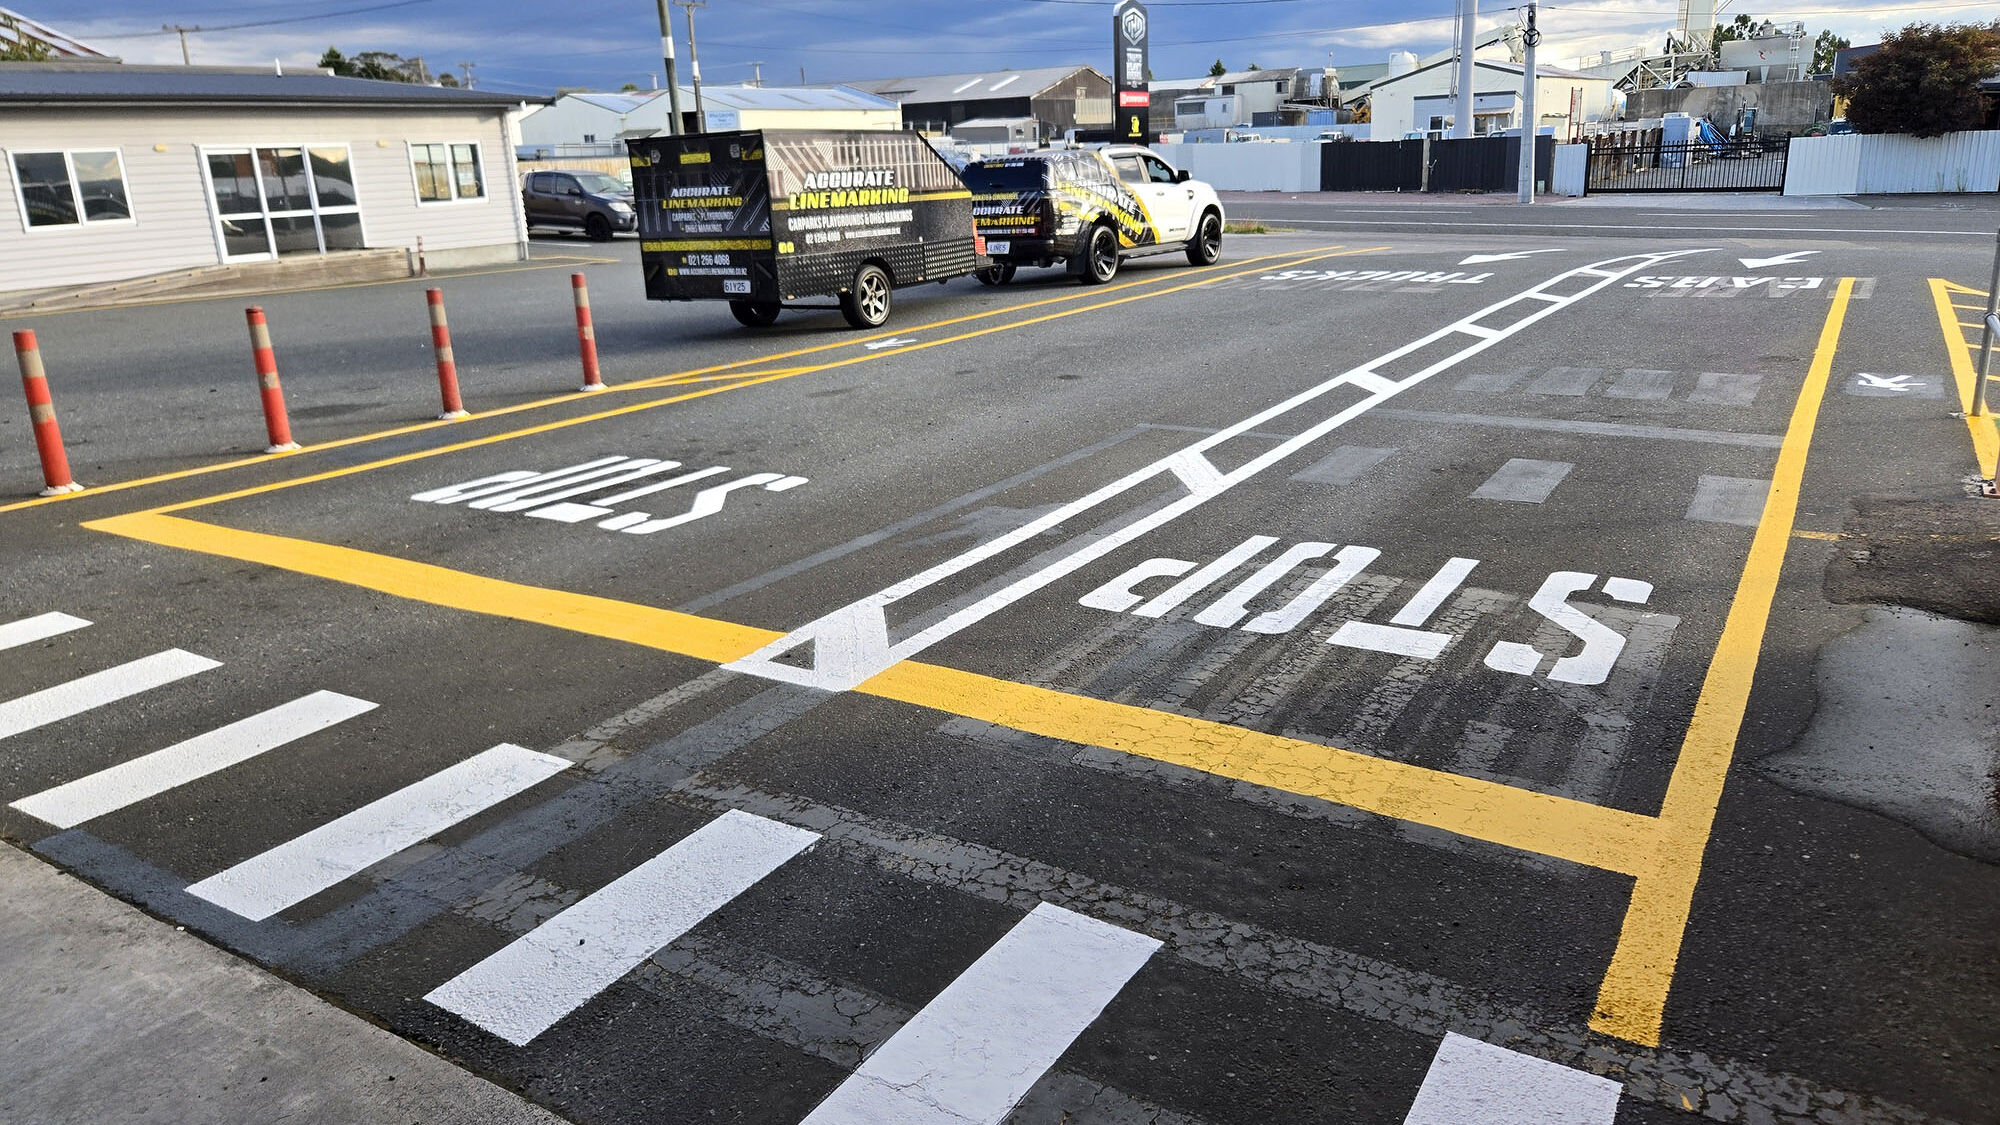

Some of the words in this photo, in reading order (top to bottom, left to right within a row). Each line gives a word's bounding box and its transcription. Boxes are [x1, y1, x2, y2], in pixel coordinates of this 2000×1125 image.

[804, 170, 894, 189] ACCURATE
[671, 186, 732, 198] ACCURATE
[789, 188, 909, 210] LINEMARKING
[662, 196, 743, 210] LINEMARKING
[973, 206, 1024, 216] CCURATE
[788, 216, 822, 231] CARPARKS
[822, 213, 864, 229] PLAYGROUNDS
[884, 209, 913, 223] MARKINGS
[688, 255, 700, 266] 021
[1260, 270, 1495, 284] TRUCKS
[1623, 276, 1825, 289] CARS
[411, 455, 809, 535] STOP
[1078, 535, 1654, 685] STOP
